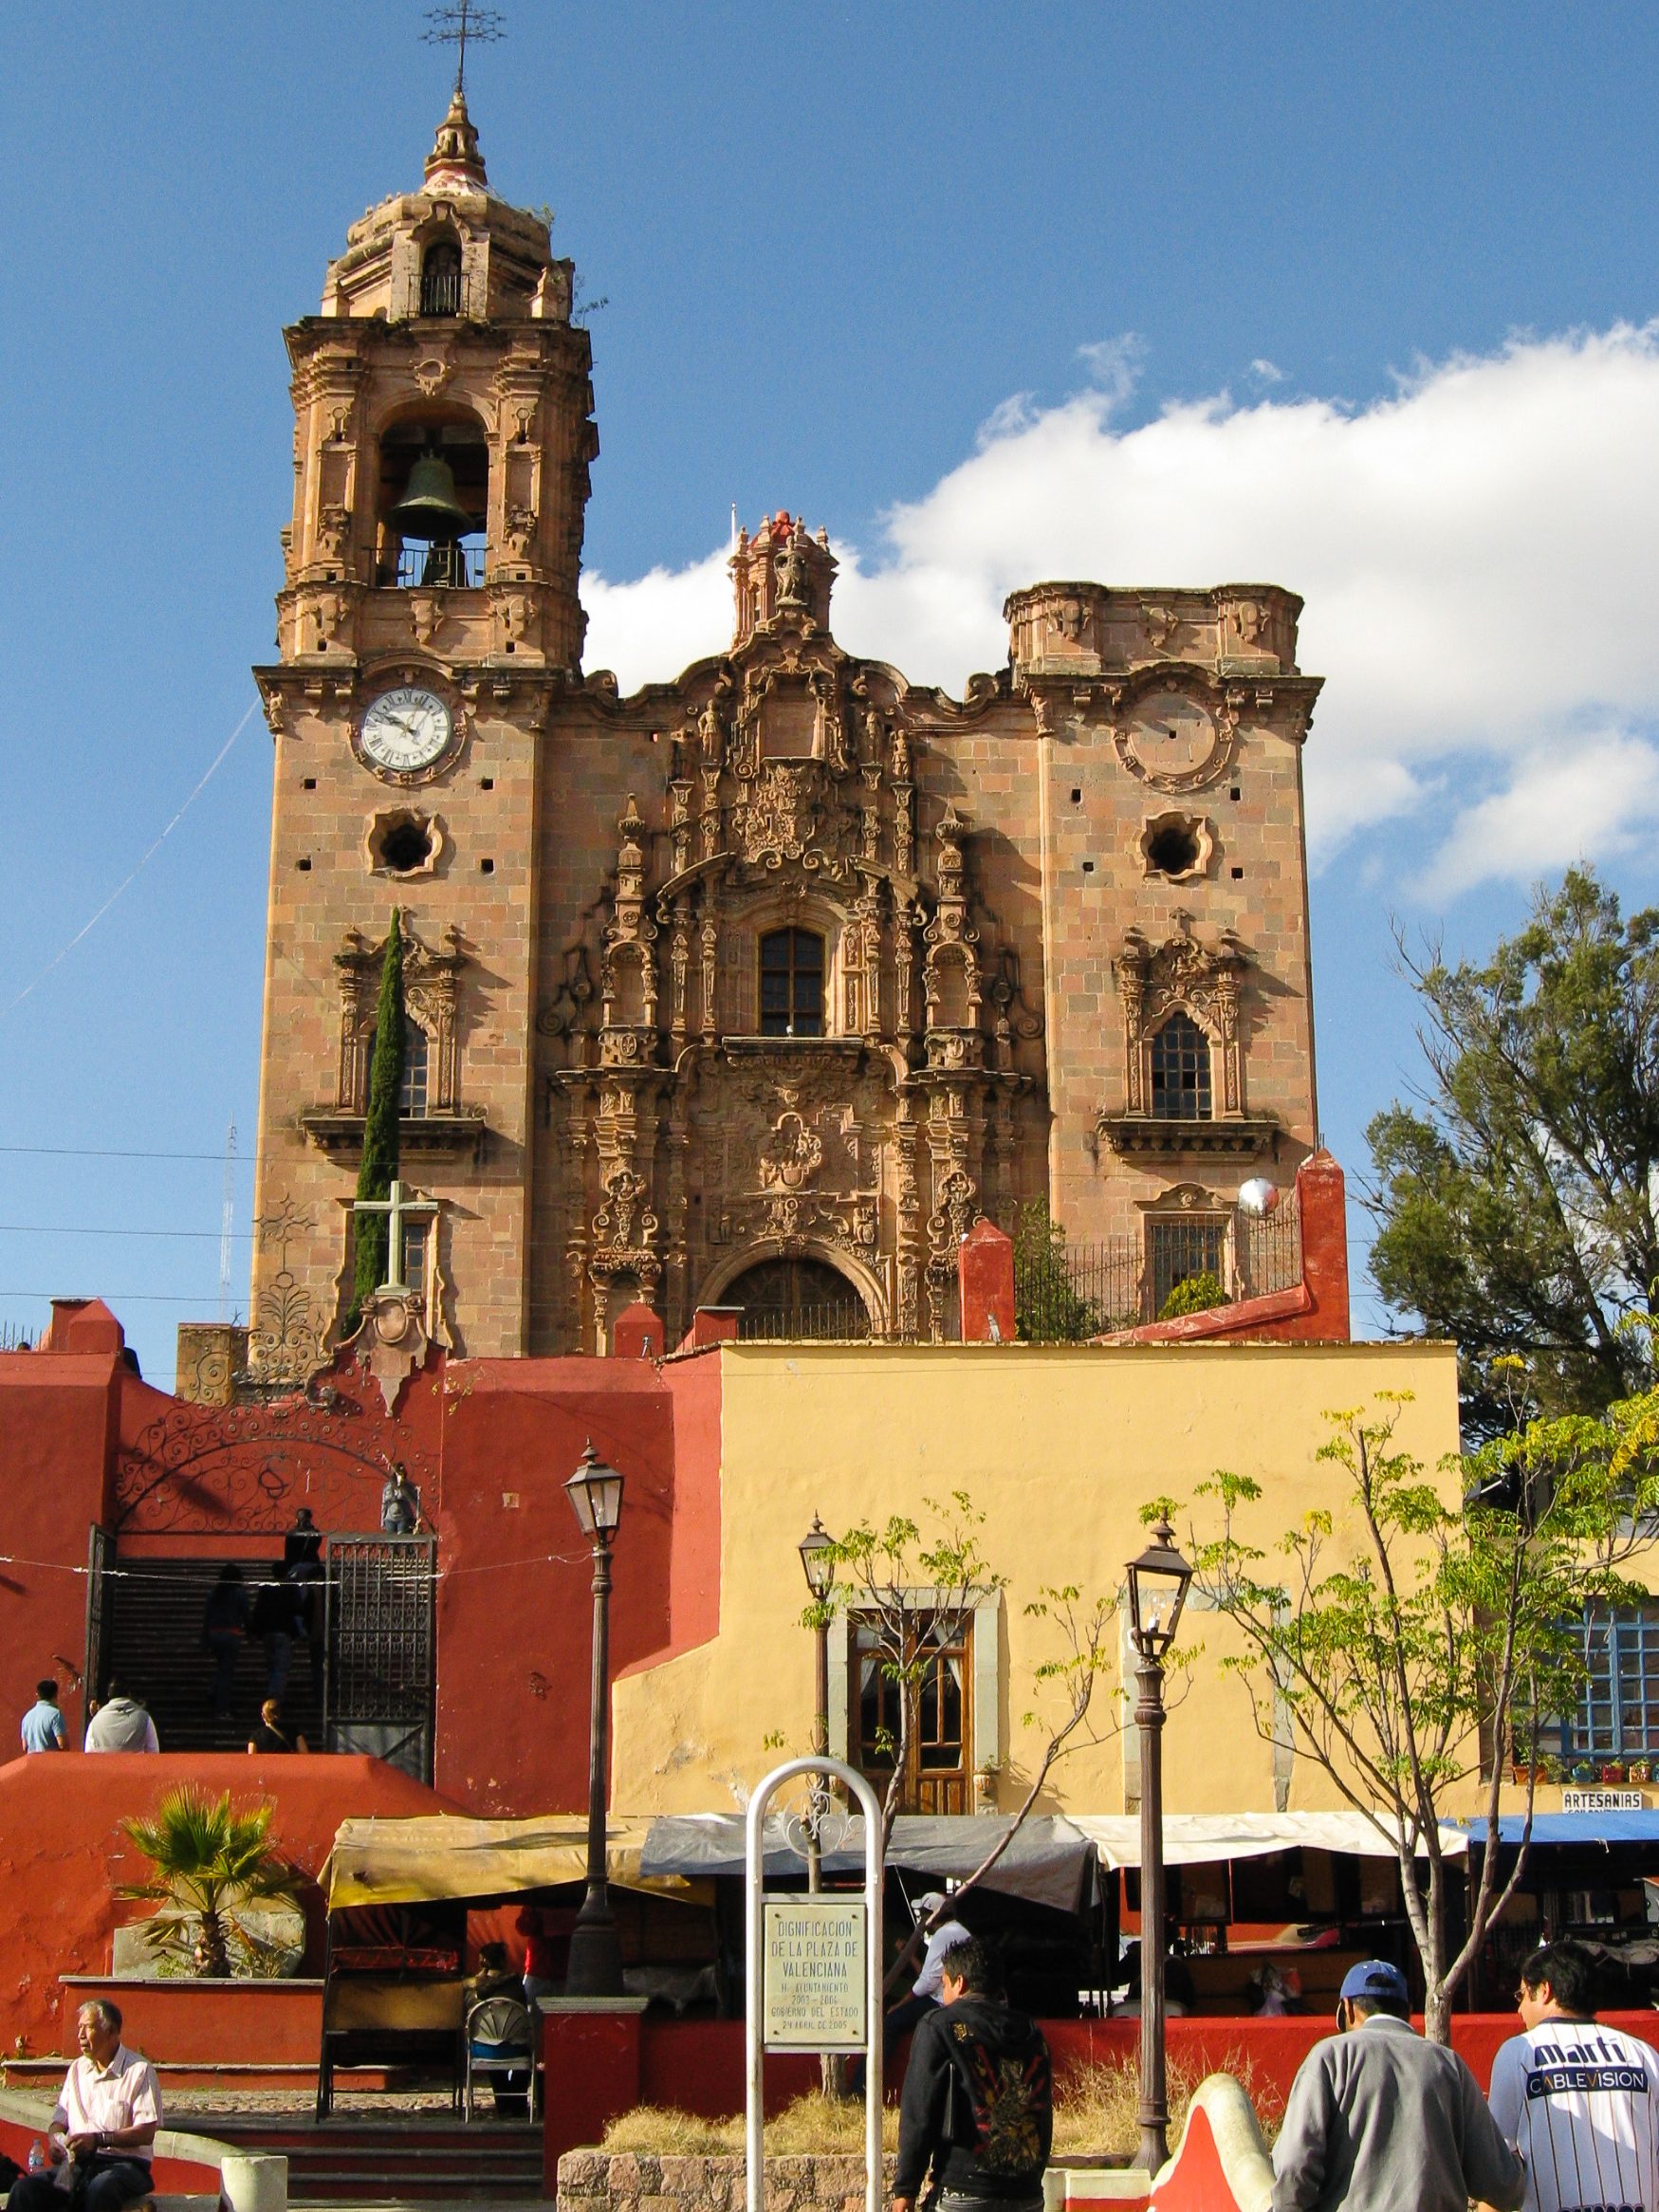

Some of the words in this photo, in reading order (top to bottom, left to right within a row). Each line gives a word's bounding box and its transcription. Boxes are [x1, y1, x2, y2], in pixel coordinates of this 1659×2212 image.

[1564, 1793, 1640, 1808] ARTESANIAS
[771, 1941, 785, 1957] DE
[789, 1941, 802, 1957] LA
[806, 1941, 840, 1957] PLAZA
[844, 1941, 857, 1957] DE
[783, 1962, 847, 1978] VALENCIANA
[795, 1982, 849, 1993] AYUNTAMIENTO
[771, 2006, 806, 2018] GOBIERNO
[811, 2006, 824, 2018] DEL
[830, 2006, 858, 2018] ESTADO
[818, 2020, 826, 2029] DE
